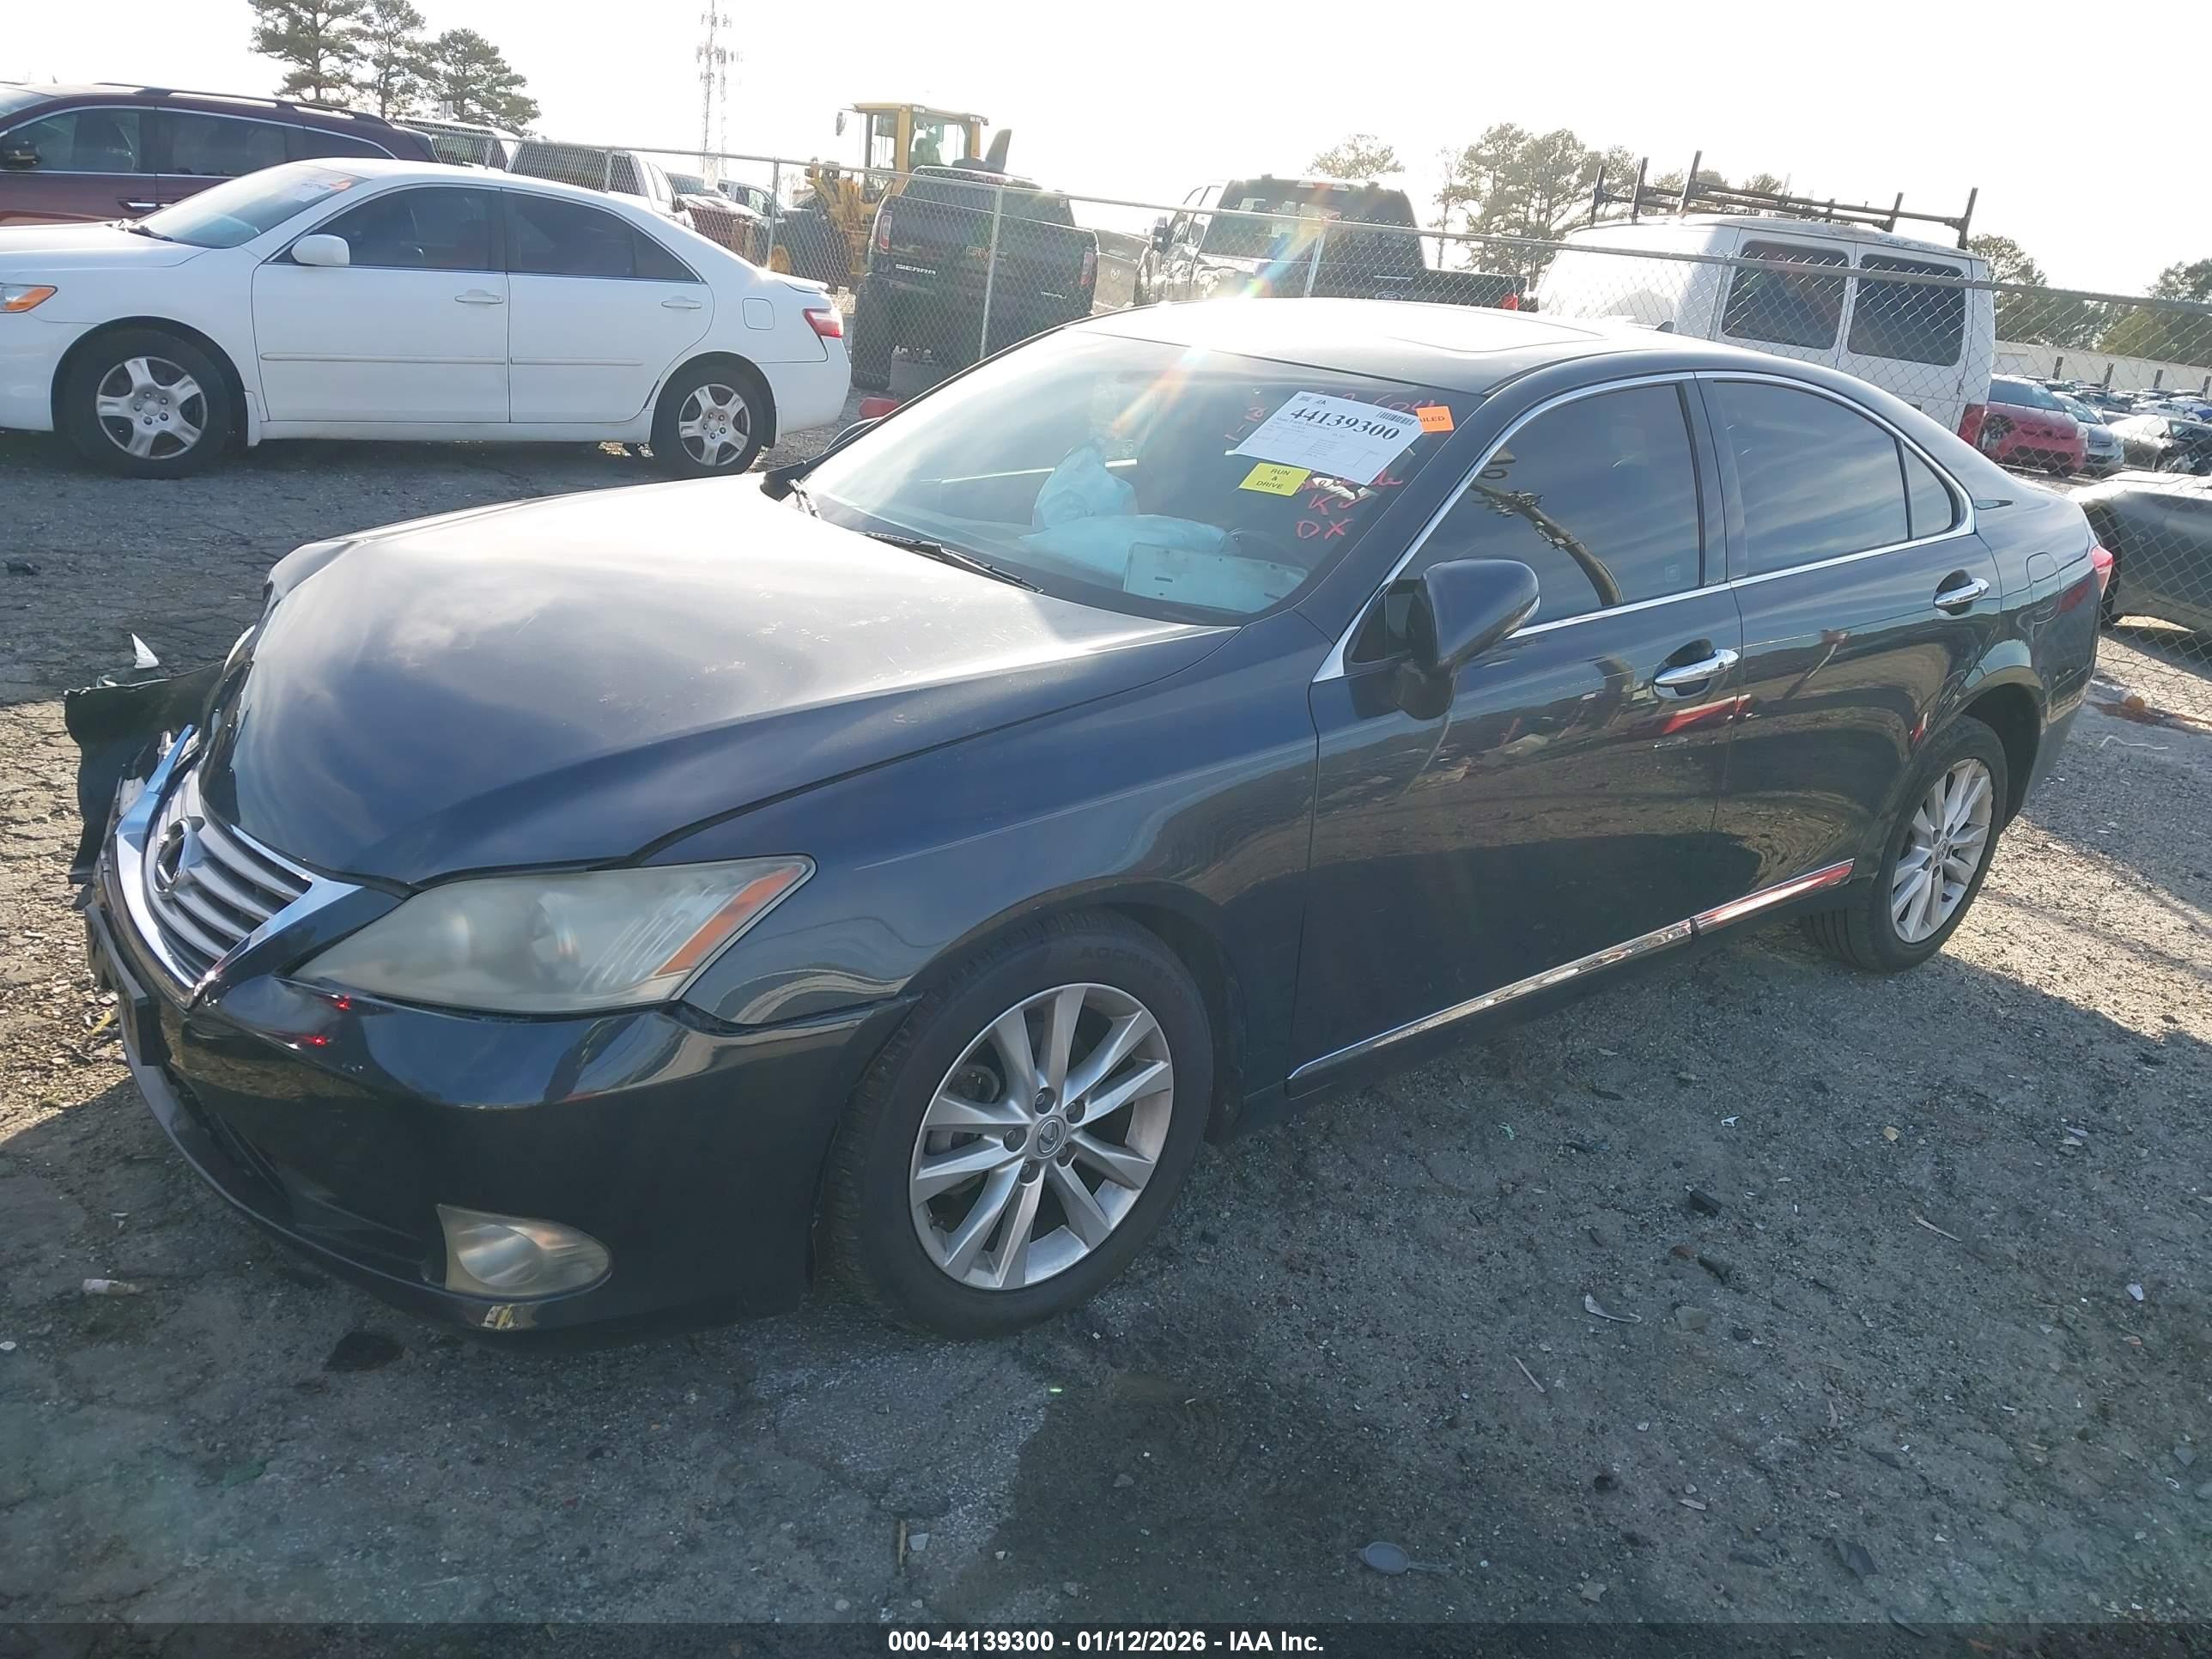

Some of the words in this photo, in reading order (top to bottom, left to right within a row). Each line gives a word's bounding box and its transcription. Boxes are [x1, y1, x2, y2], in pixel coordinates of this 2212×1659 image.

[895, 263, 937, 276] SIERRA
[1290, 406, 1401, 441] 44139300
[1270, 467, 1291, 477] RUN
[1255, 479, 1284, 489] DRIVE
